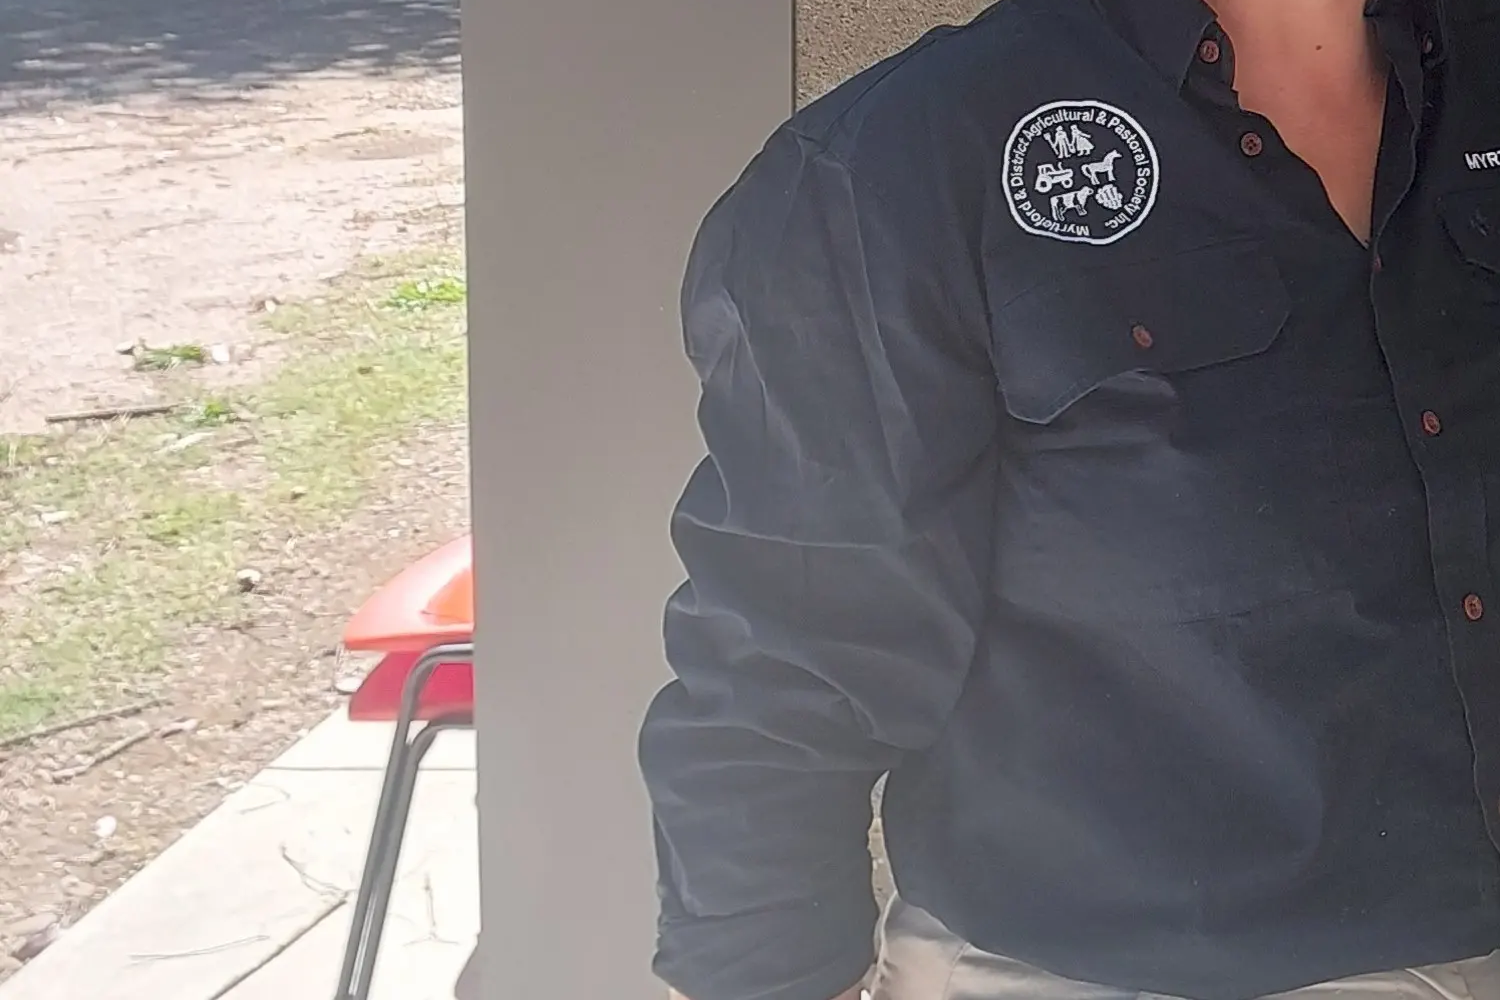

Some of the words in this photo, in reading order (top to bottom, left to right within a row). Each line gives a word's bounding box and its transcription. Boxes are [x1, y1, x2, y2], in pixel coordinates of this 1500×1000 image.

[1021, 108, 1095, 142] Agricultural
[1095, 110, 1107, 126] &
[1107, 116, 1150, 166] Pastoral
[1010, 136, 1031, 187] District
[1013, 187, 1027, 201] &
[1124, 166, 1151, 216] Society
[1017, 200, 1090, 236] Myrtleford
